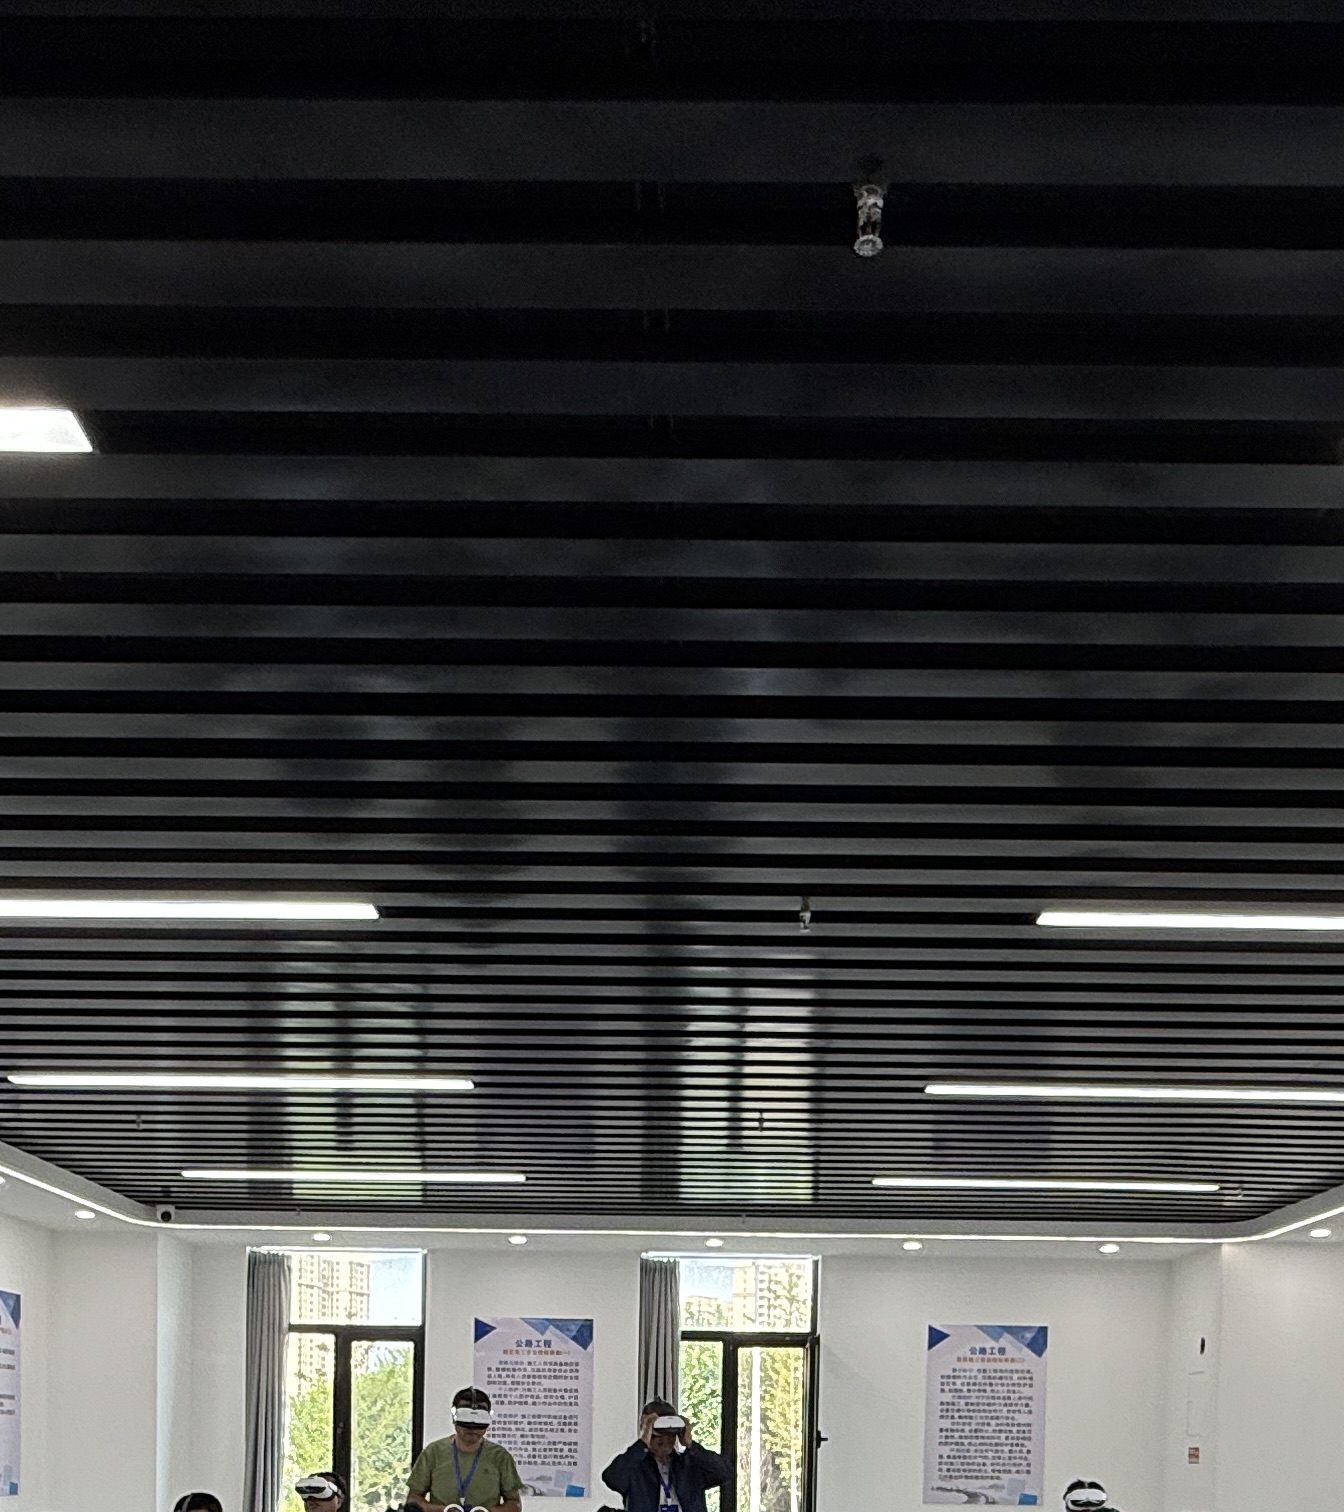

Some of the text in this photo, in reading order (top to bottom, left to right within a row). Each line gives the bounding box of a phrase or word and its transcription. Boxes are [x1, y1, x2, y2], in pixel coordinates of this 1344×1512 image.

[515, 1339, 552, 1349] 公路工程
[969, 1346, 1006, 1356] 公路工程
